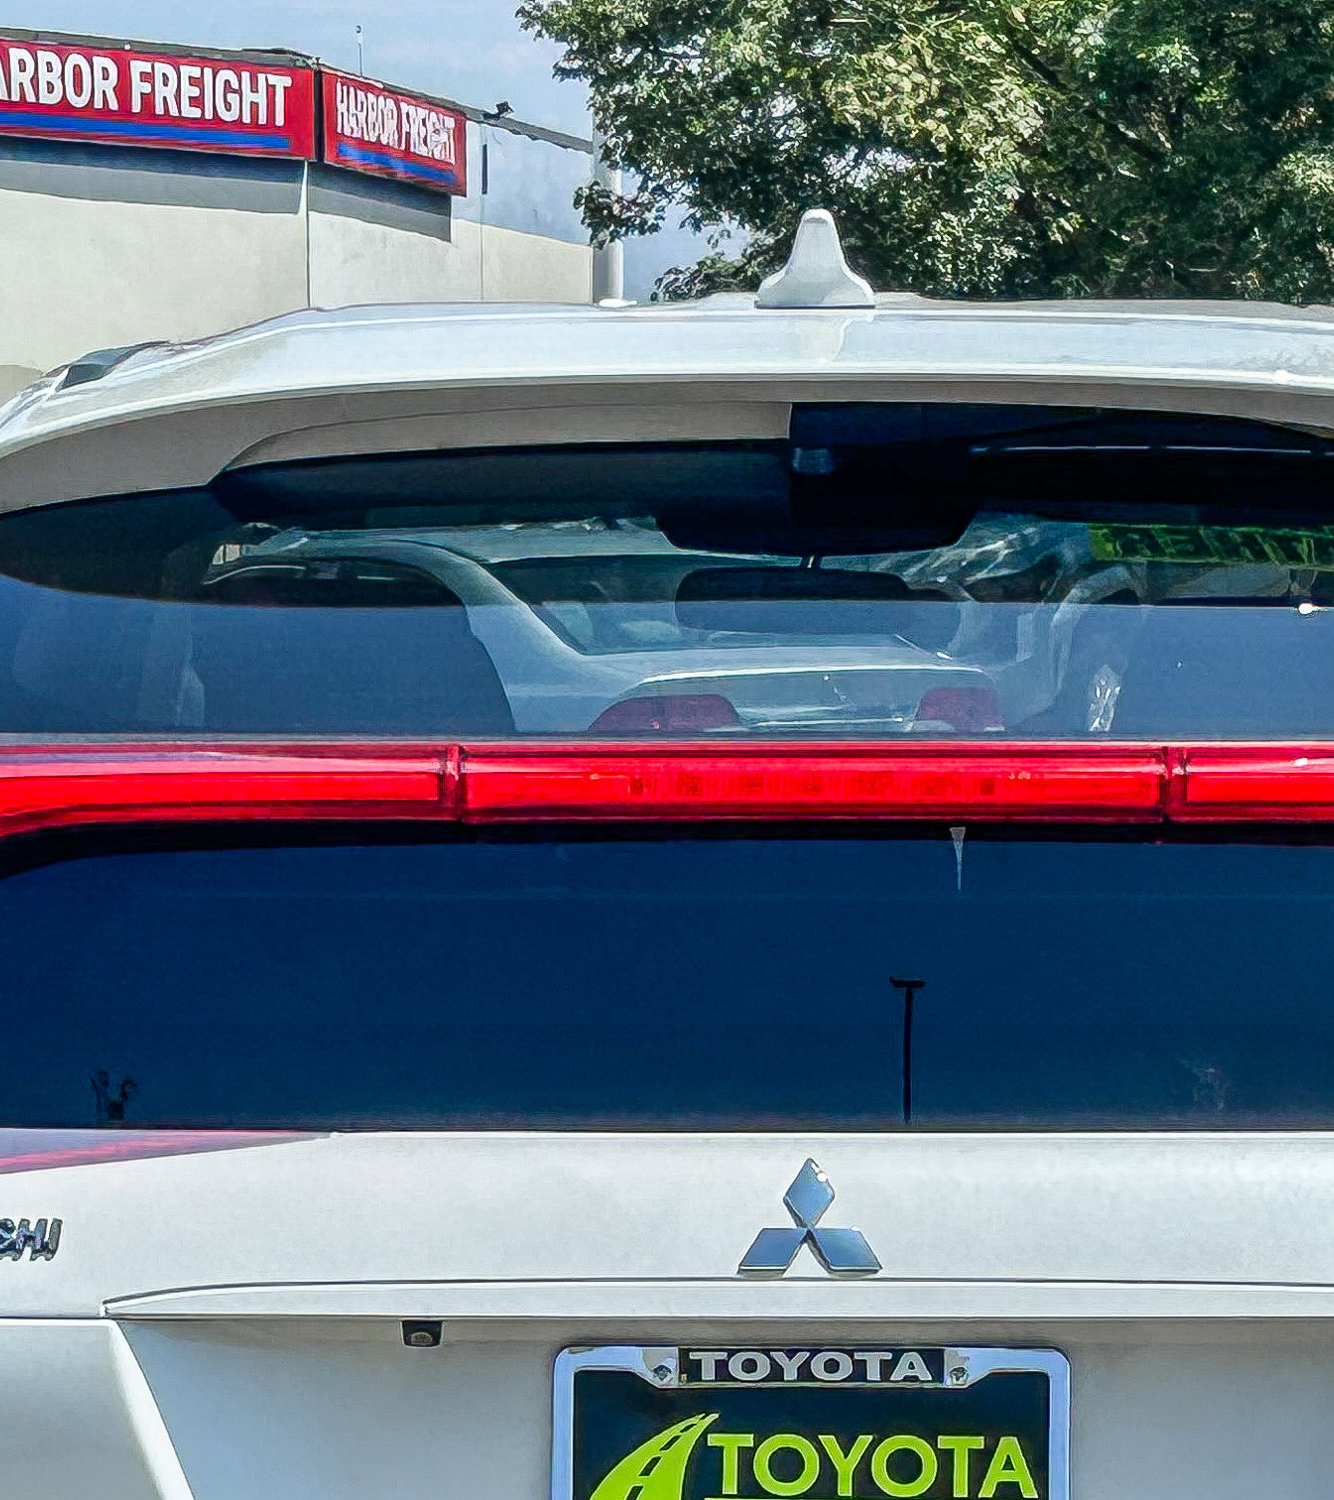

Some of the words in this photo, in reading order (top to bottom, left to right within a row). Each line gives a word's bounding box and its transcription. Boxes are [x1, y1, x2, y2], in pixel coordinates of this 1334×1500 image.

[130, 58, 292, 127] FREIGHT
[336, 78, 399, 150] HARBOR
[399, 101, 456, 165] FREIGHT
[688, 1350, 932, 1382] TOYOTA
[706, 1432, 1040, 1499] TOYOTA
